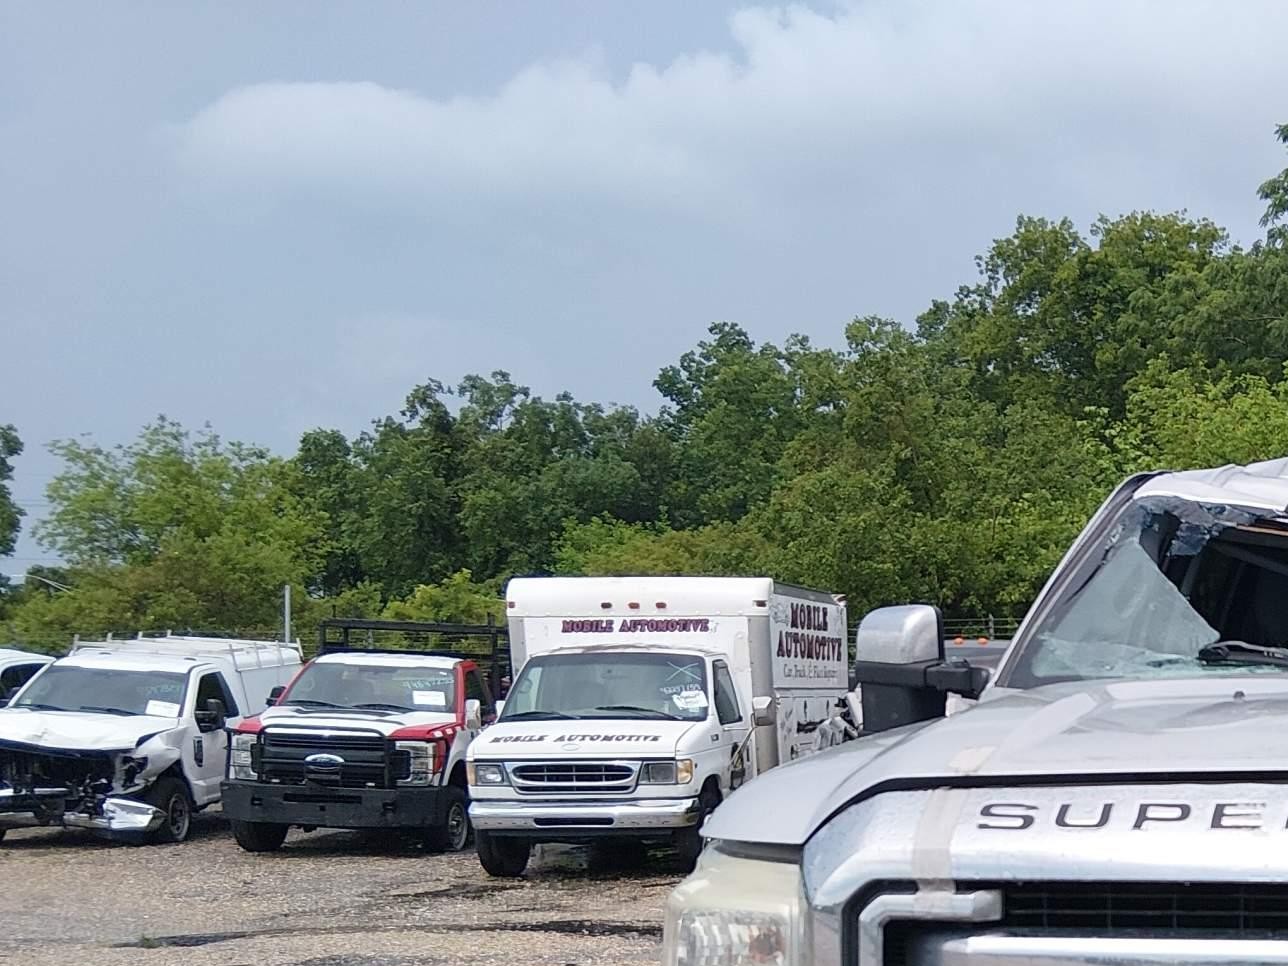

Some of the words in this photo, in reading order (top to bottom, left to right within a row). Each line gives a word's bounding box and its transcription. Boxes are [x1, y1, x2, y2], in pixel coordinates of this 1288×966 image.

[561, 619, 614, 634] MOBILE
[618, 618, 710, 633] AUTOMOTIVE
[790, 602, 829, 632] MOBILE
[776, 630, 843, 662] AUTOMOTIVE
[489, 734, 550, 744] MOBILE
[553, 734, 663, 743] AUTOMOTIVE
